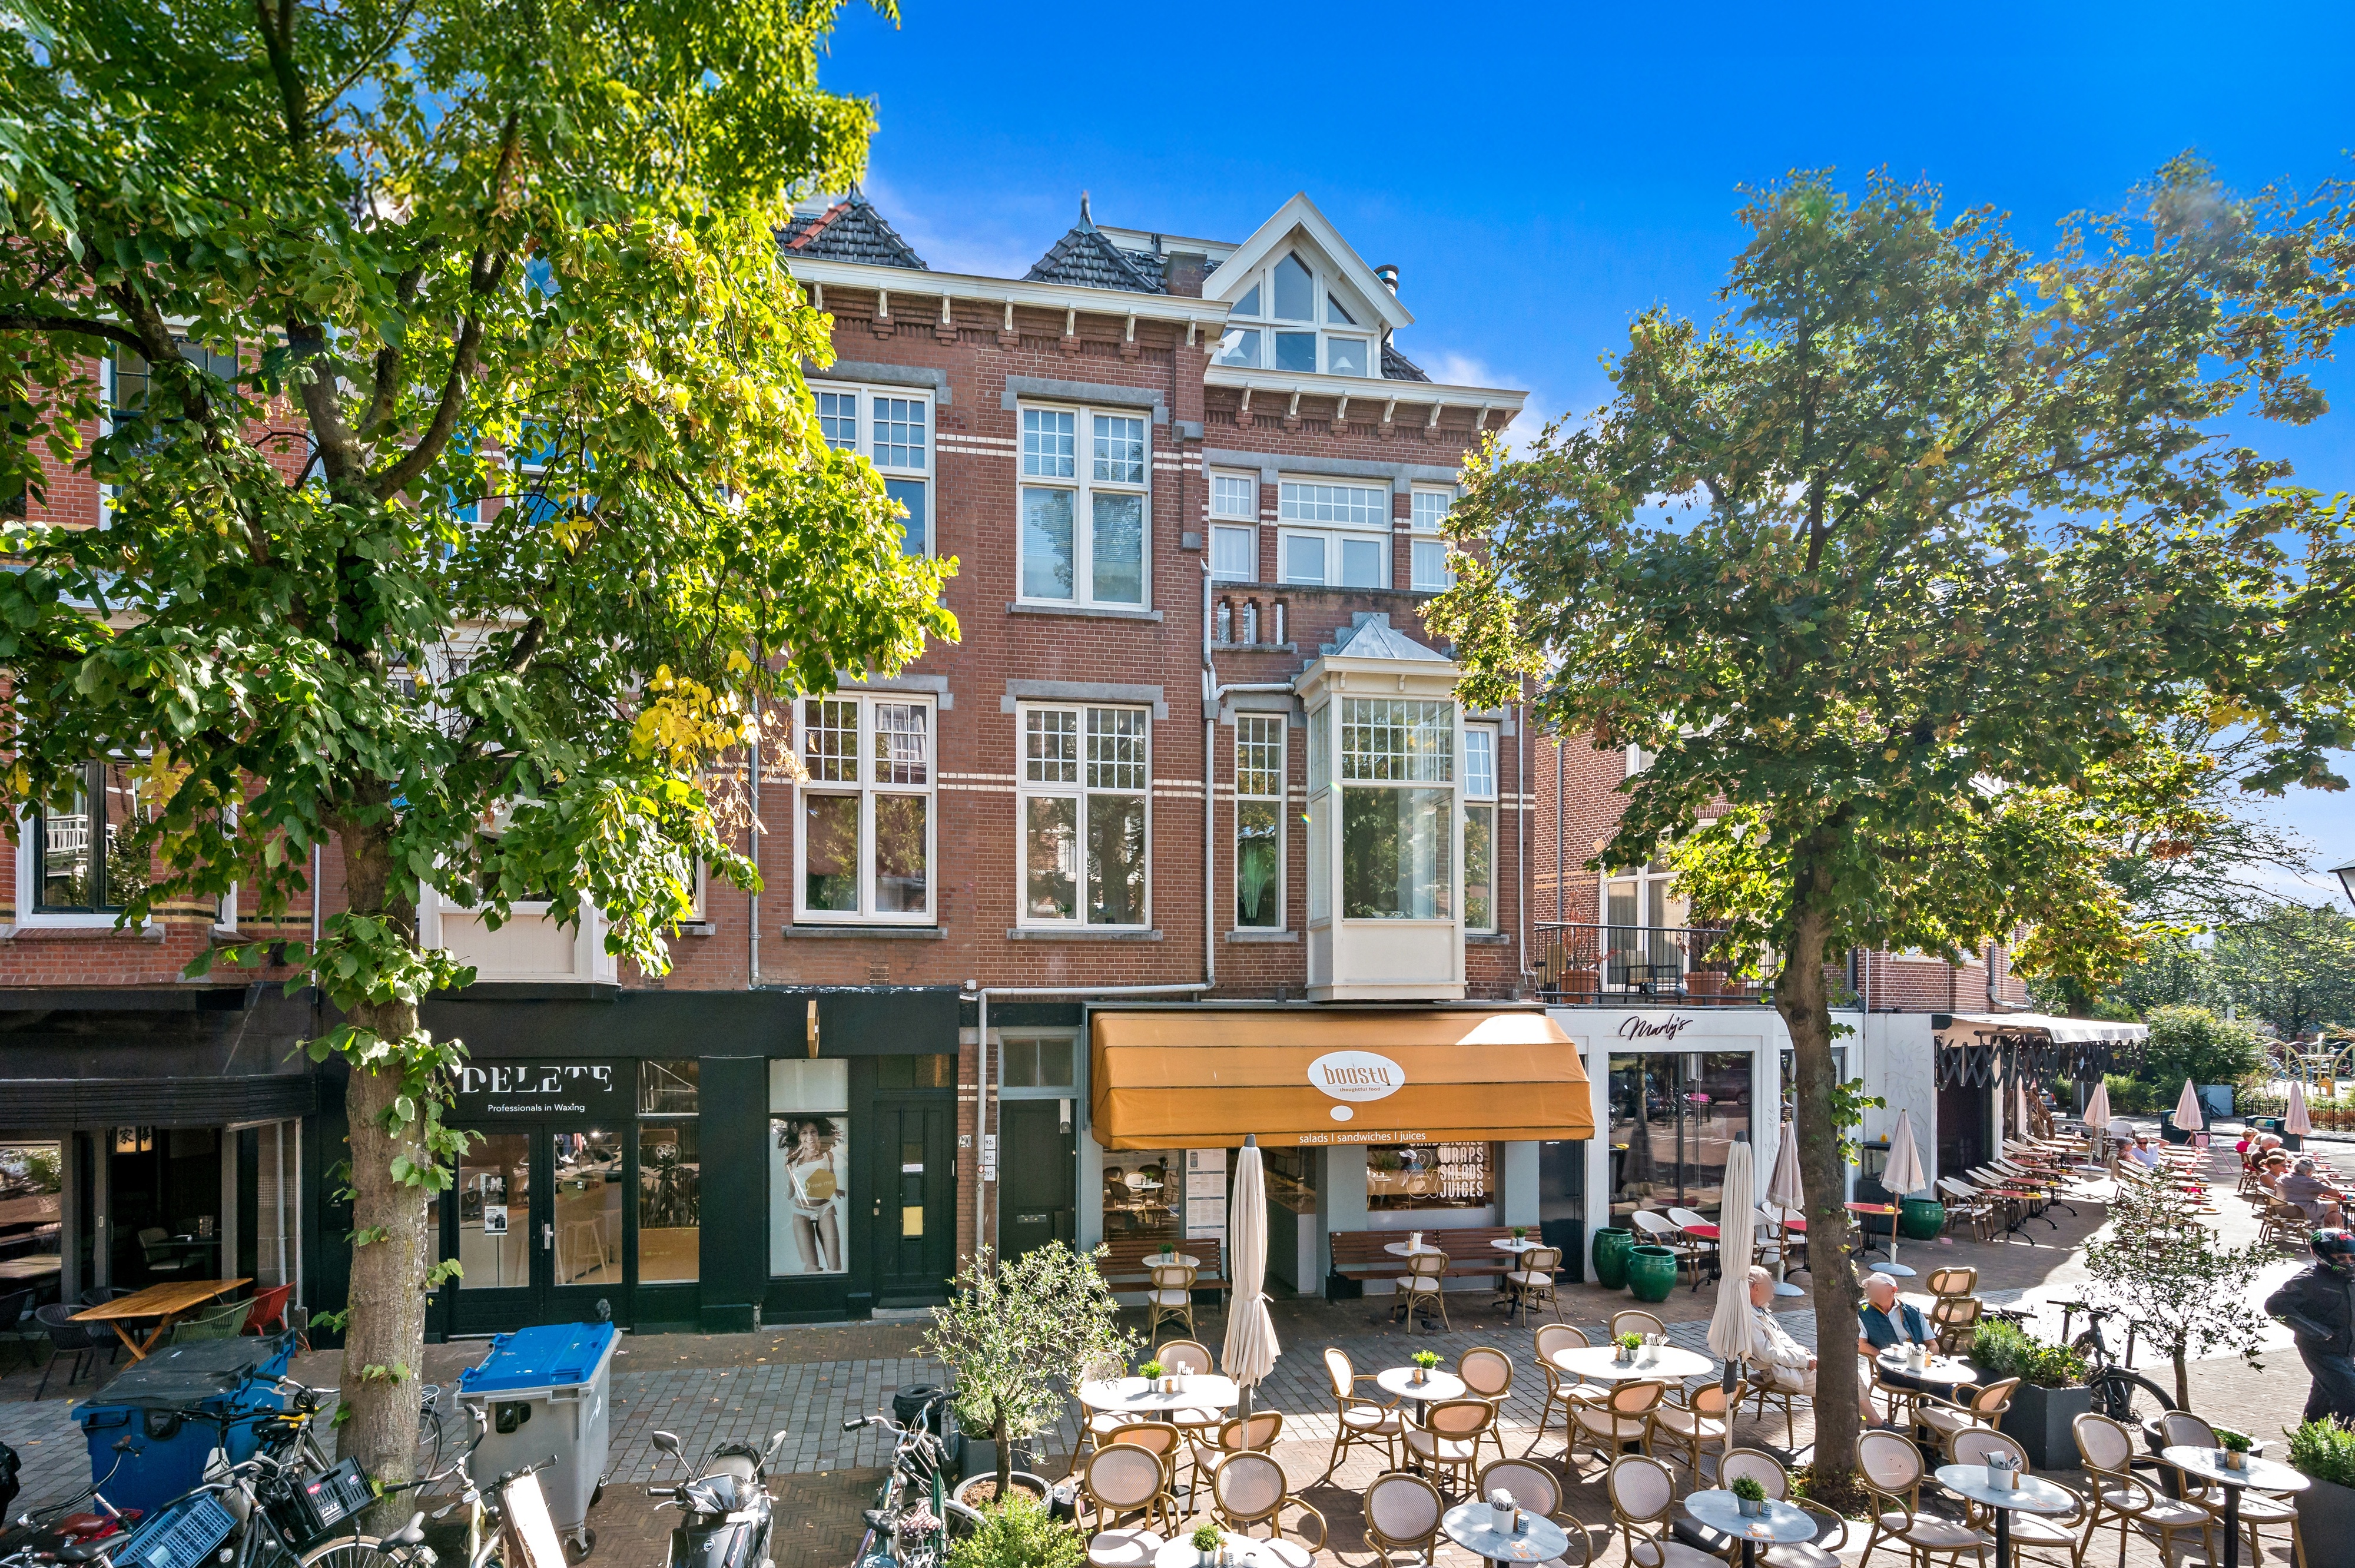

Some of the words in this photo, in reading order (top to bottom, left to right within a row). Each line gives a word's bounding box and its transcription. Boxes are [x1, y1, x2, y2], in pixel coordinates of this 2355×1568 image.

[1619, 1013, 1693, 1040] Marly's
[460, 1066, 612, 1093] DELETE
[1322, 1064, 1391, 1086] boosty
[487, 1103, 542, 1112] Professionals
[545, 1103, 552, 1112] in
[554, 1103, 585, 1112] Waxing
[959, 1136, 971, 1148] 290
[1299, 1133, 1328, 1143] salads
[1337, 1132, 1391, 1142] sandwiches
[1399, 1131, 1426, 1142] juices
[1439, 1146, 1484, 1163] WRAPS
[1439, 1163, 1484, 1181] SALADS
[1439, 1181, 1484, 1198] JUICES
